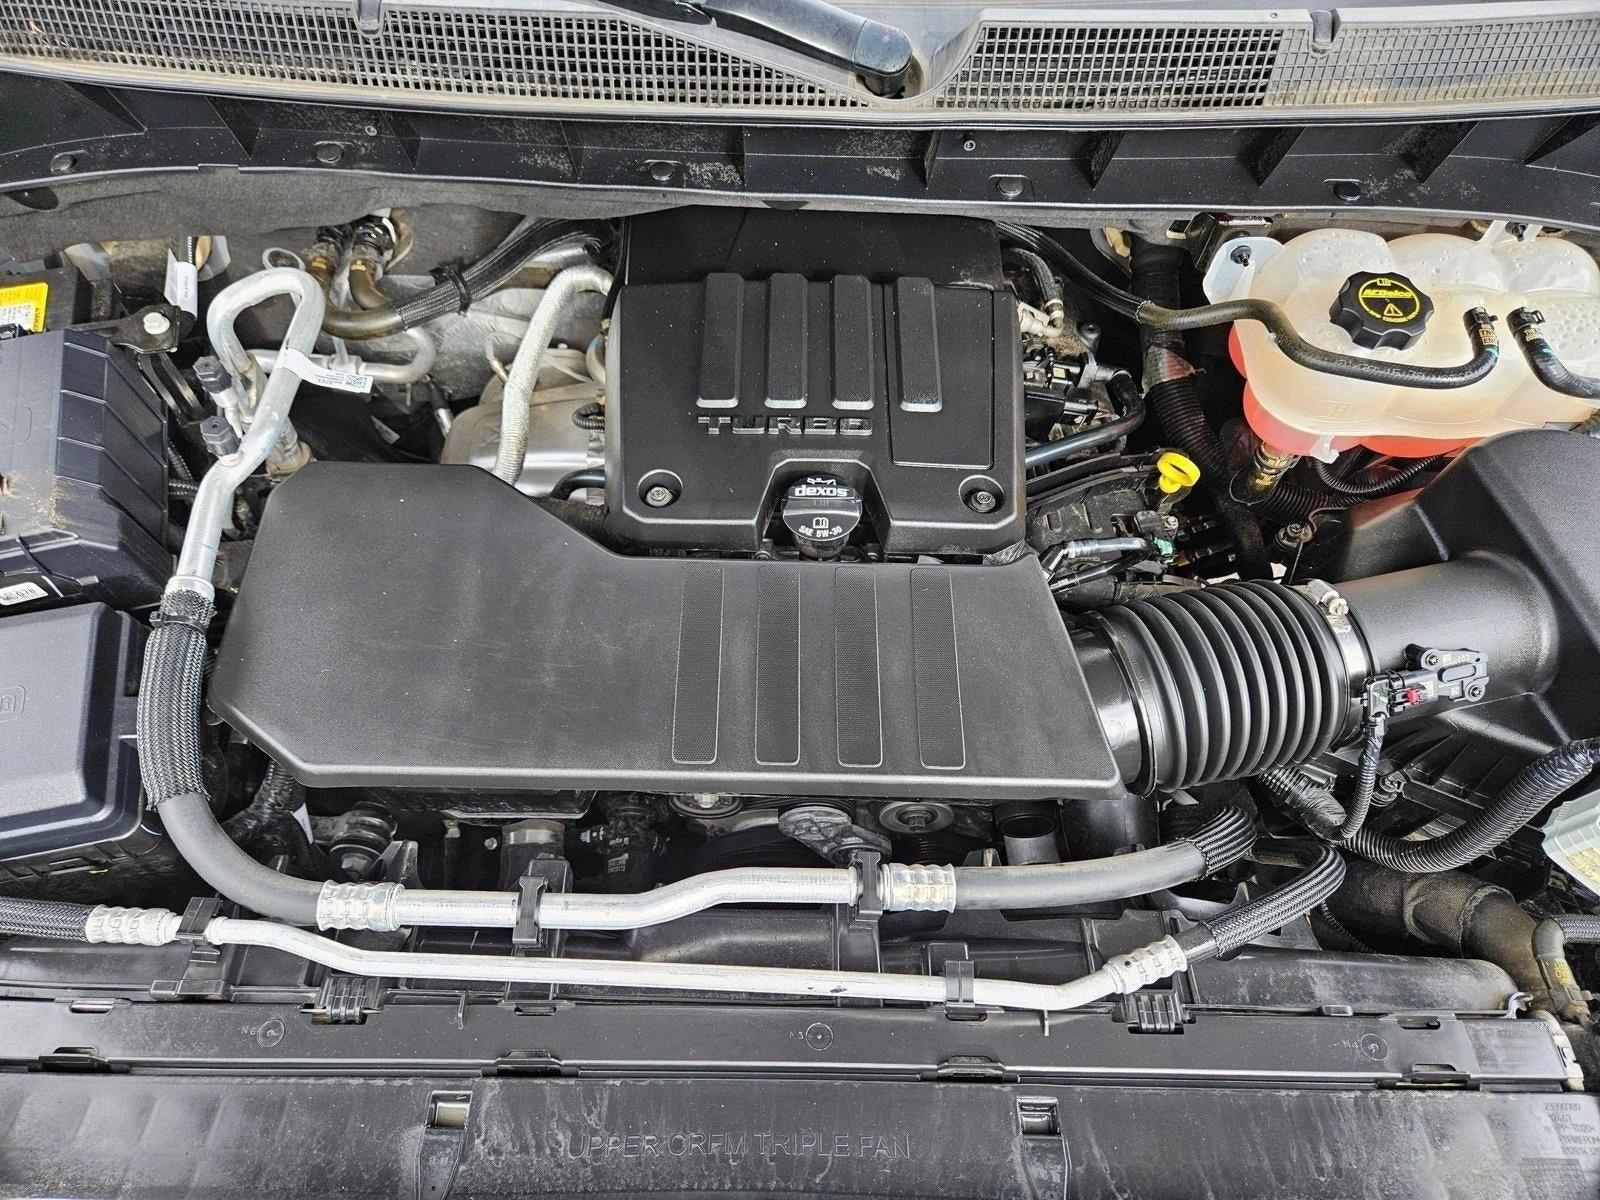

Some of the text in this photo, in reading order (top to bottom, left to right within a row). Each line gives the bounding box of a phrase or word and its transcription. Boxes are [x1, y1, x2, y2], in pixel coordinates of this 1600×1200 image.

[1362, 288, 1414, 298] ACDelco
[697, 416, 873, 436] TURBO
[794, 484, 850, 497] dexos
[798, 525, 843, 538] SAE 5W-30
[569, 1132, 660, 1160] UPPER
[756, 1132, 851, 1159] TRIPLE
[858, 1133, 912, 1160] FAN
